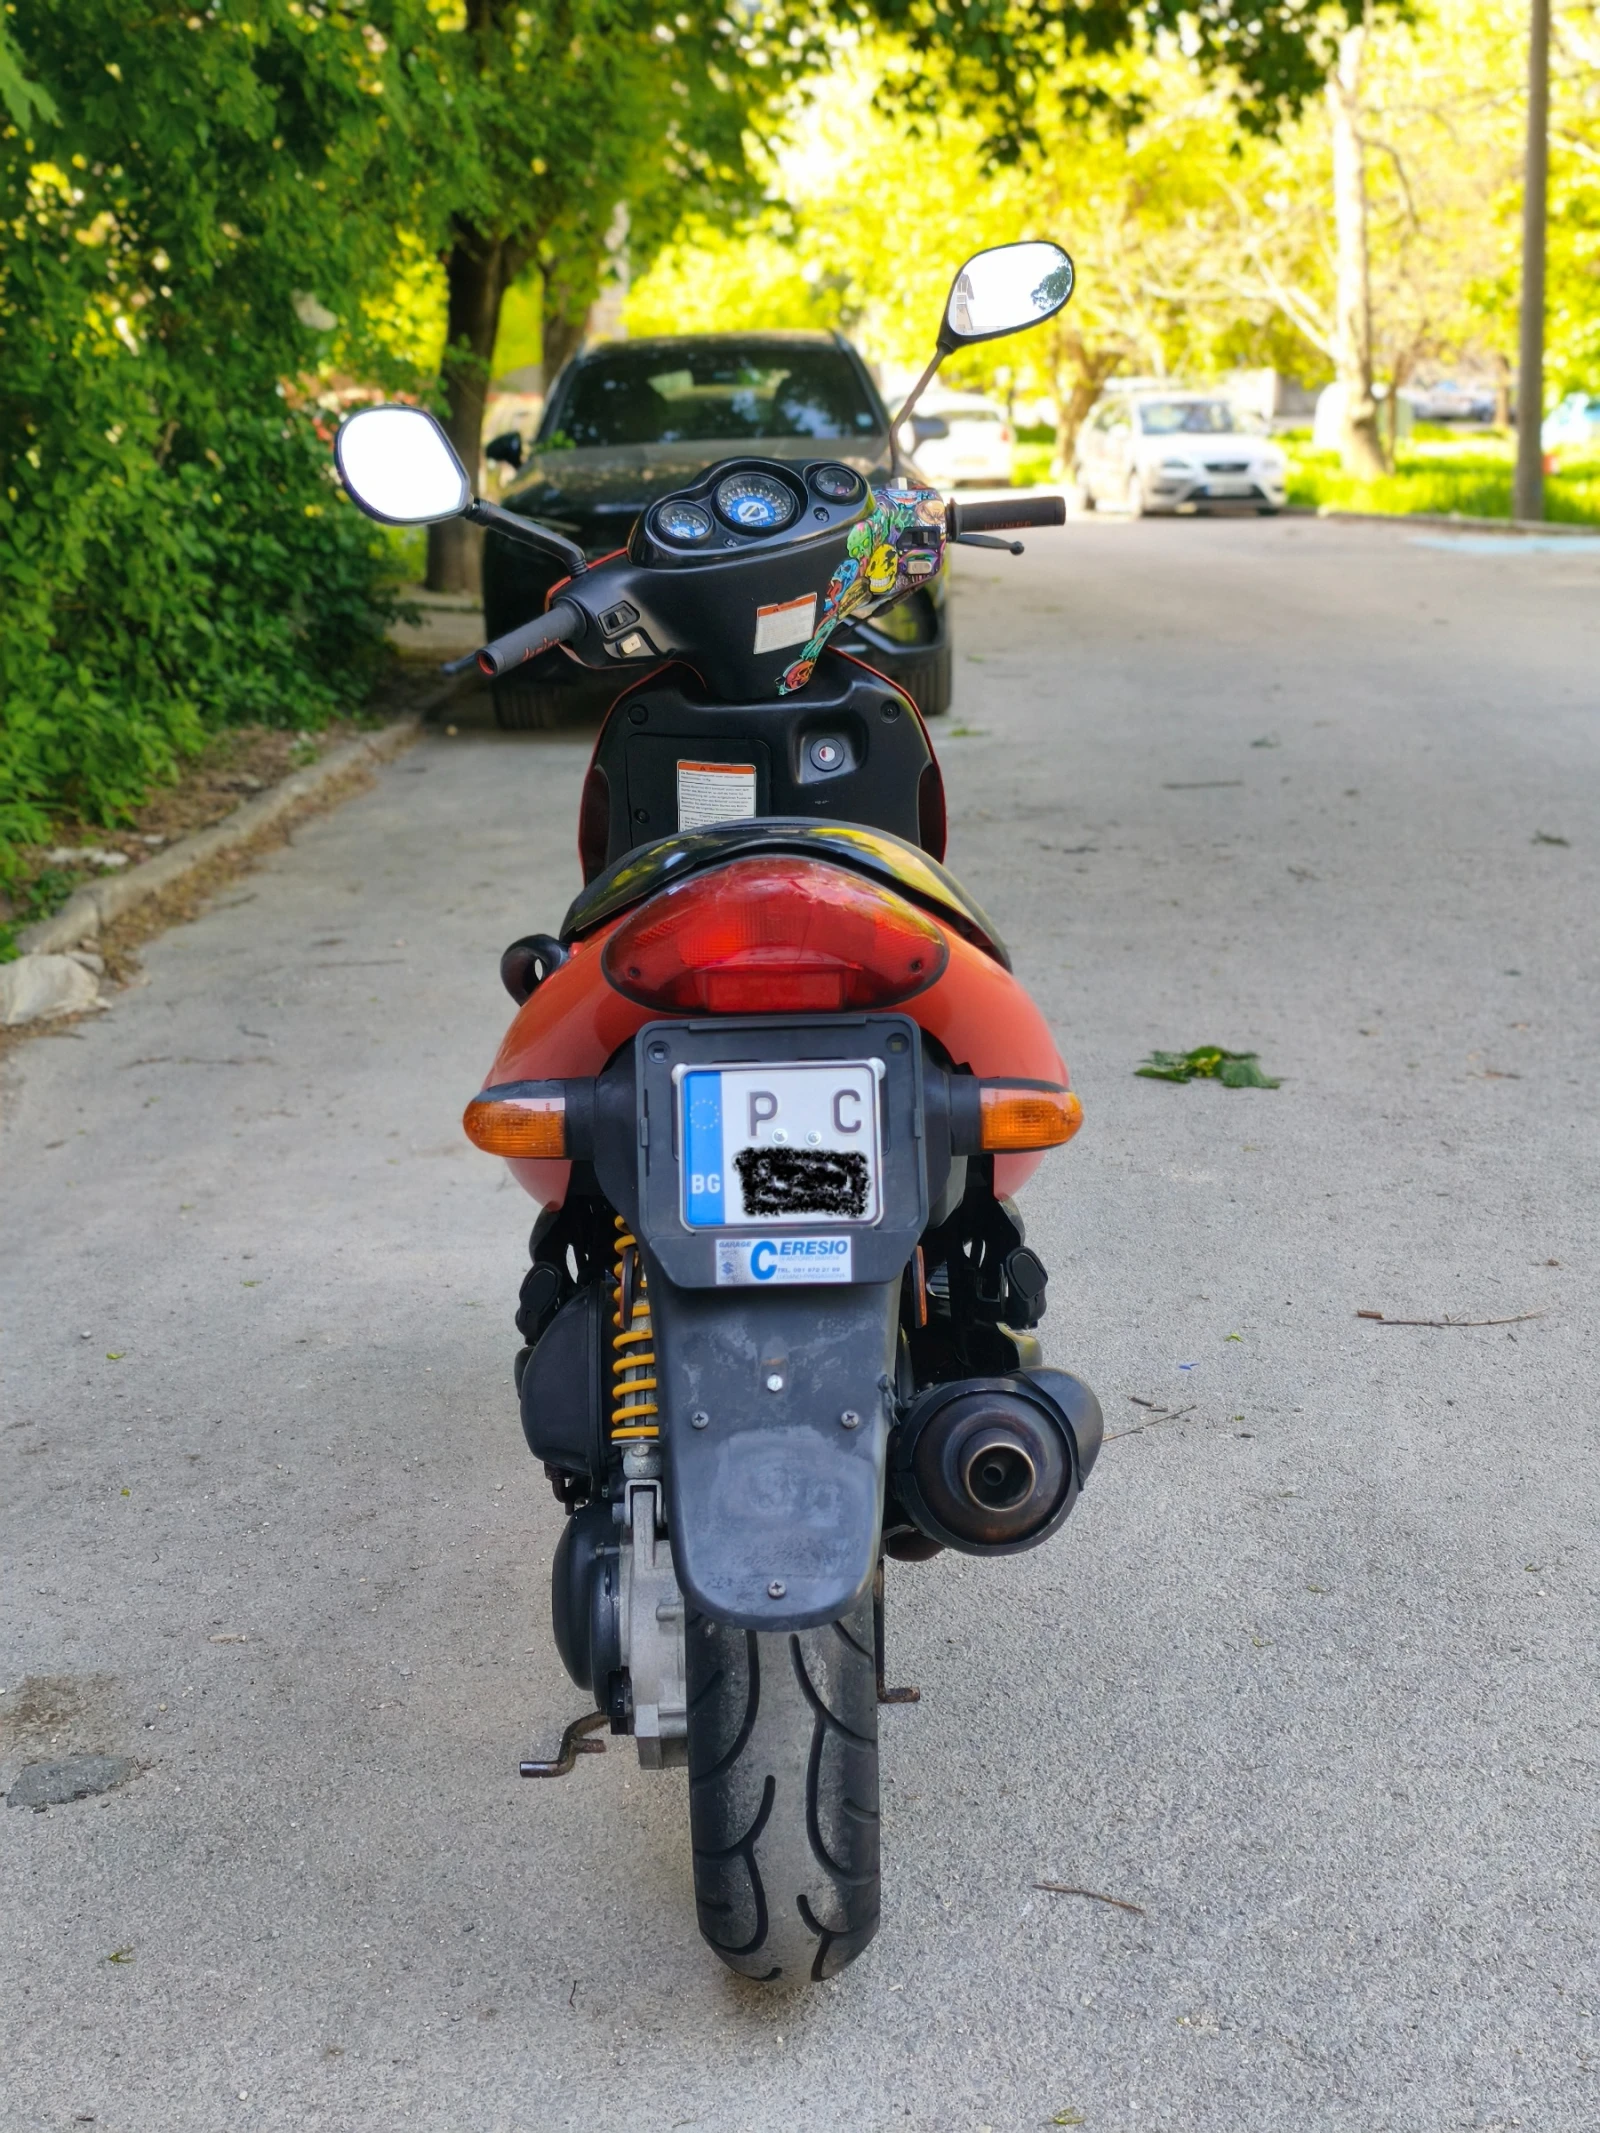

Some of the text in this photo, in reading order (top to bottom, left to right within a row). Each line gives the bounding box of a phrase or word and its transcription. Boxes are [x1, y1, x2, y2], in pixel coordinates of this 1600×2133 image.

[749, 1088, 861, 1137] P C
[691, 1174, 721, 1195] BG
